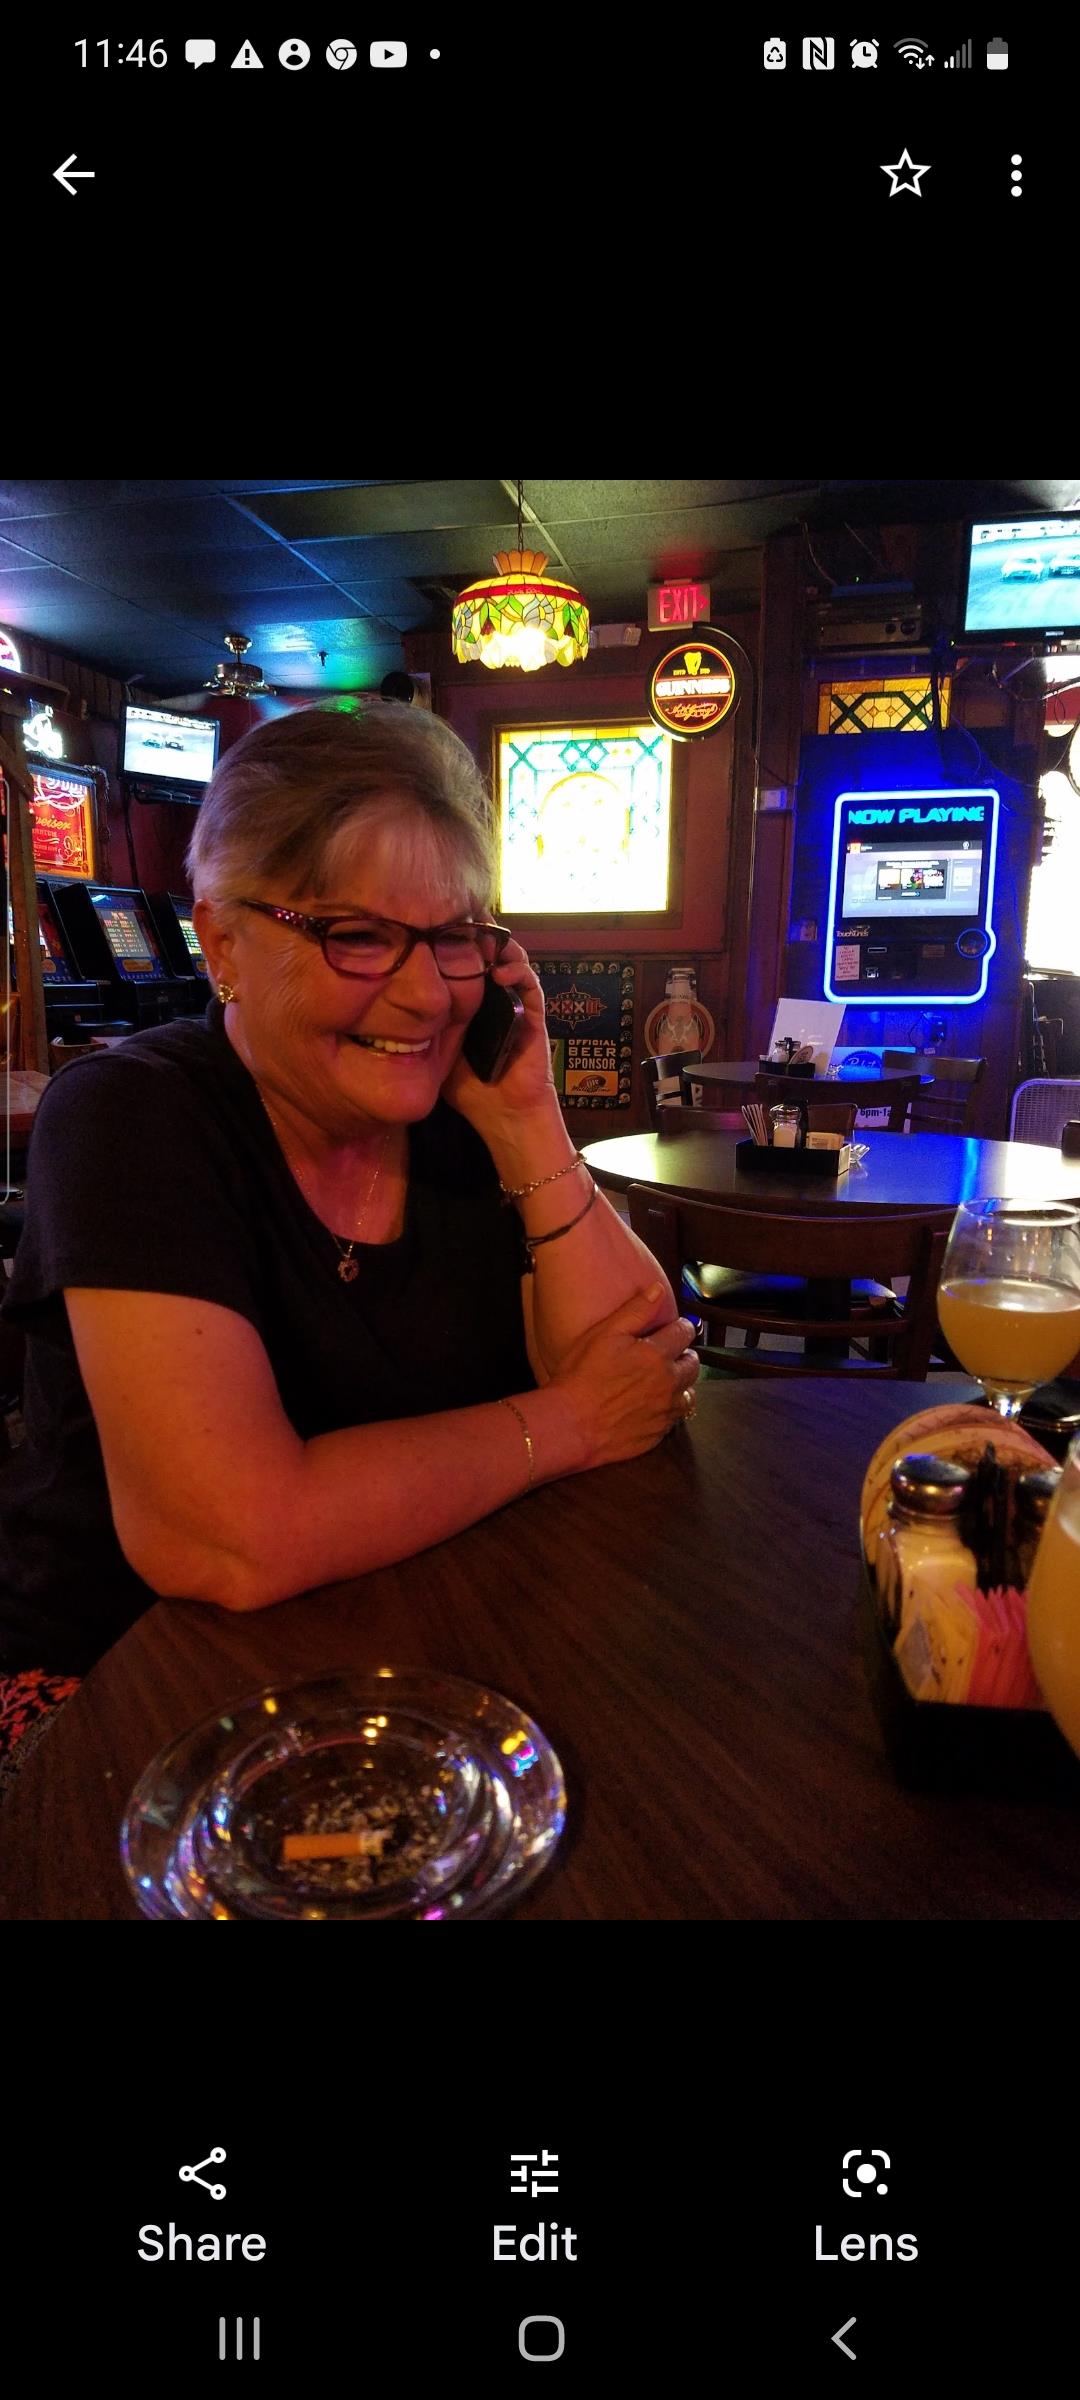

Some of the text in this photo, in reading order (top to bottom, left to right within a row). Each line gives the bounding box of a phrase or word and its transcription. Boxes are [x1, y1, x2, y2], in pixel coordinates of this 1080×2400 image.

[659, 588, 699, 623] EXIT
[848, 809, 895, 824] NOW
[568, 1047, 616, 1057] BEER
[568, 1058, 616, 1070] SPONSOR
